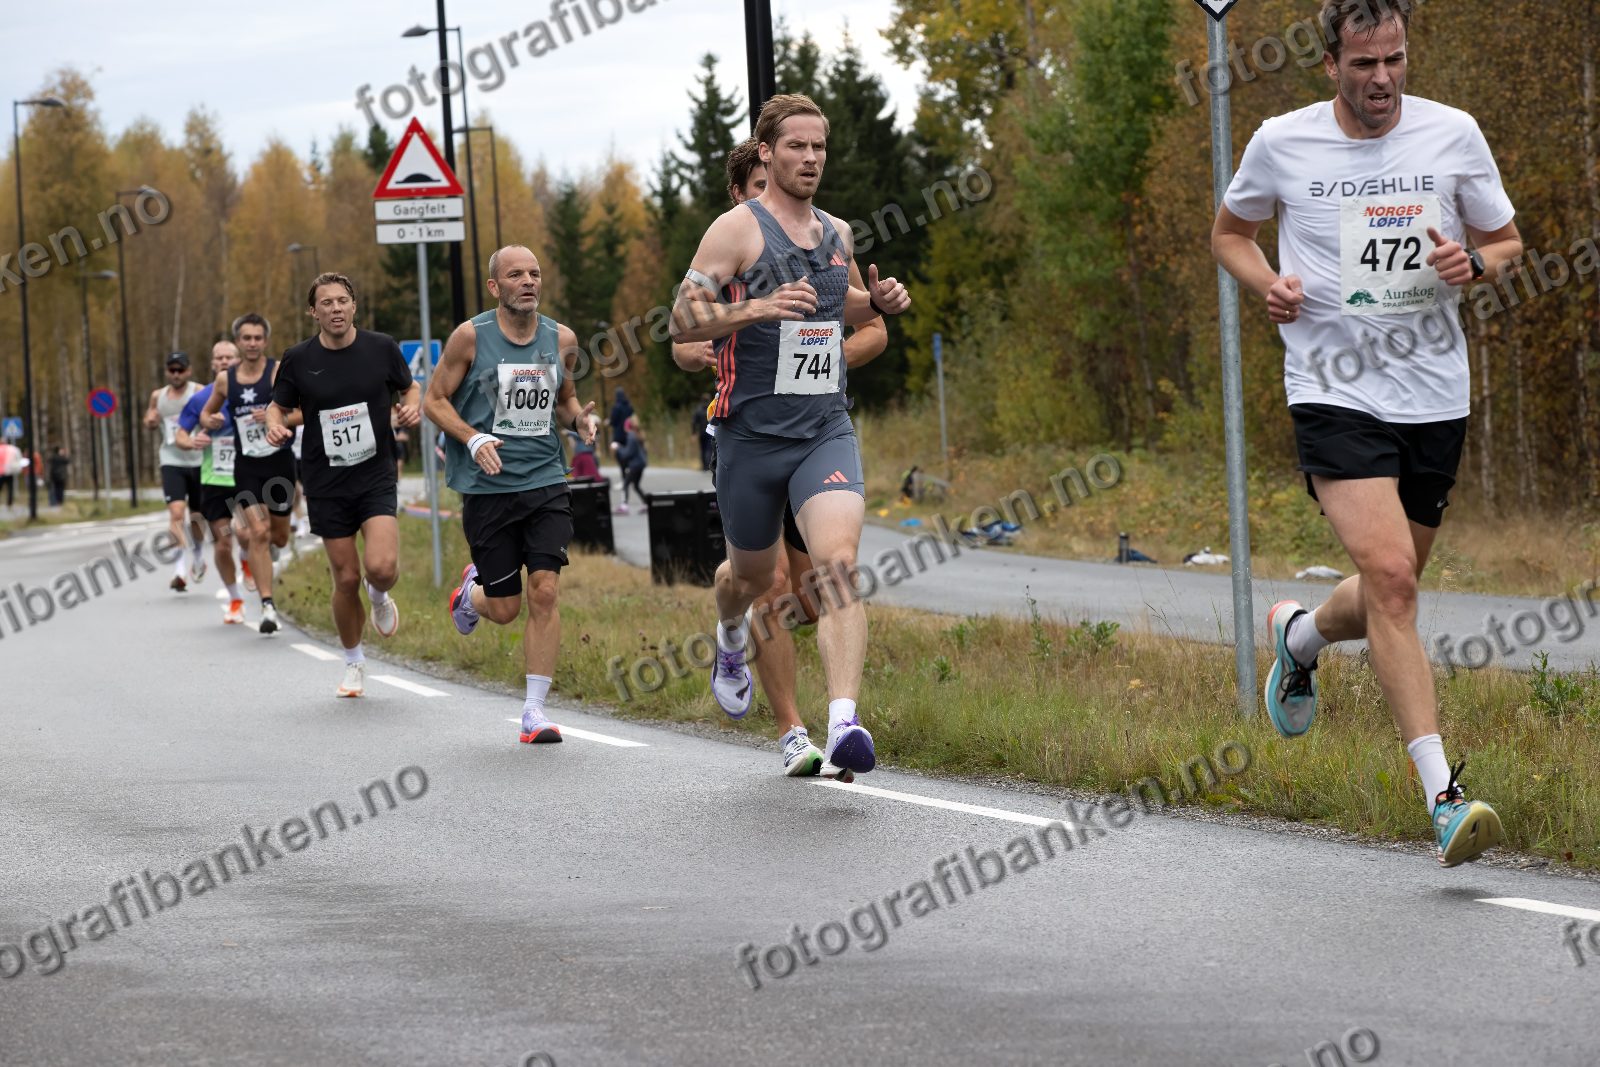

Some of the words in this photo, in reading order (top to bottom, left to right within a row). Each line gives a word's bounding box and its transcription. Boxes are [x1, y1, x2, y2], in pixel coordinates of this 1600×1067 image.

[393, 203, 446, 217] Gangfelt
[1361, 205, 1424, 217] NORGES
[1368, 216, 1415, 228] LØPET
[397, 228, 406, 239] 0
[1360, 236, 1422, 272] 472
[1382, 286, 1435, 300] Aurskog
[798, 328, 834, 337] NORGES
[800, 337, 829, 346] LØPET
[793, 352, 831, 380] 744
[505, 388, 550, 410] 1008
[329, 409, 359, 420] NORGES
[332, 416, 354, 425] LØPET
[518, 419, 549, 429] Aurskog
[332, 424, 361, 447] 517
